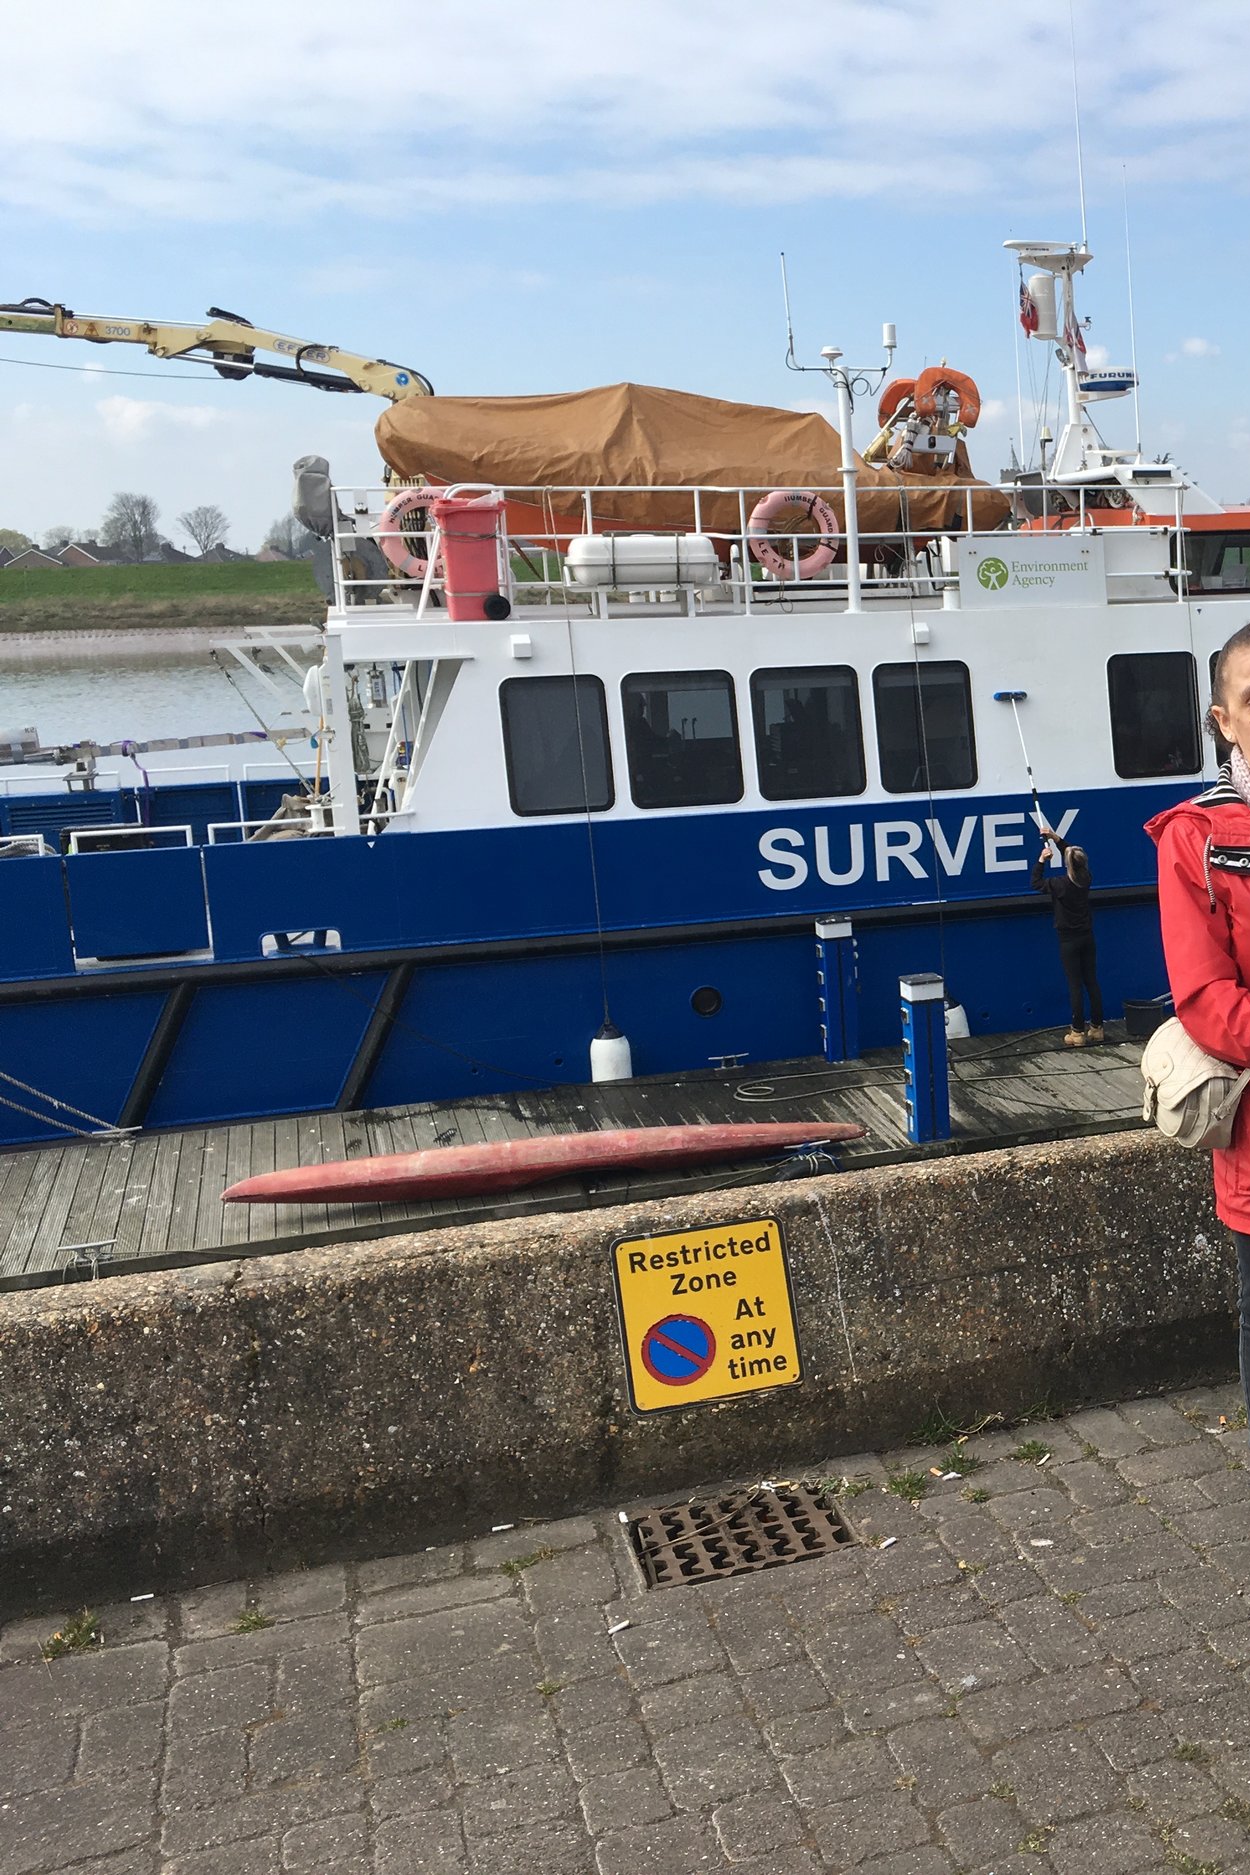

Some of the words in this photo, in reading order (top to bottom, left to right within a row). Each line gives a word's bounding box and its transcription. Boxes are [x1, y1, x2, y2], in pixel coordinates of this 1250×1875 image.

[105, 326, 131, 336] 3700
[1011, 561, 1088, 573] Environment
[1012, 575, 1055, 588] Agency
[758, 809, 1080, 891] SURVEY
[629, 1231, 771, 1273] Restricted
[670, 1270, 737, 1295] Zone
[735, 1296, 766, 1320] At
[730, 1327, 776, 1350] any
[728, 1355, 787, 1380] time
